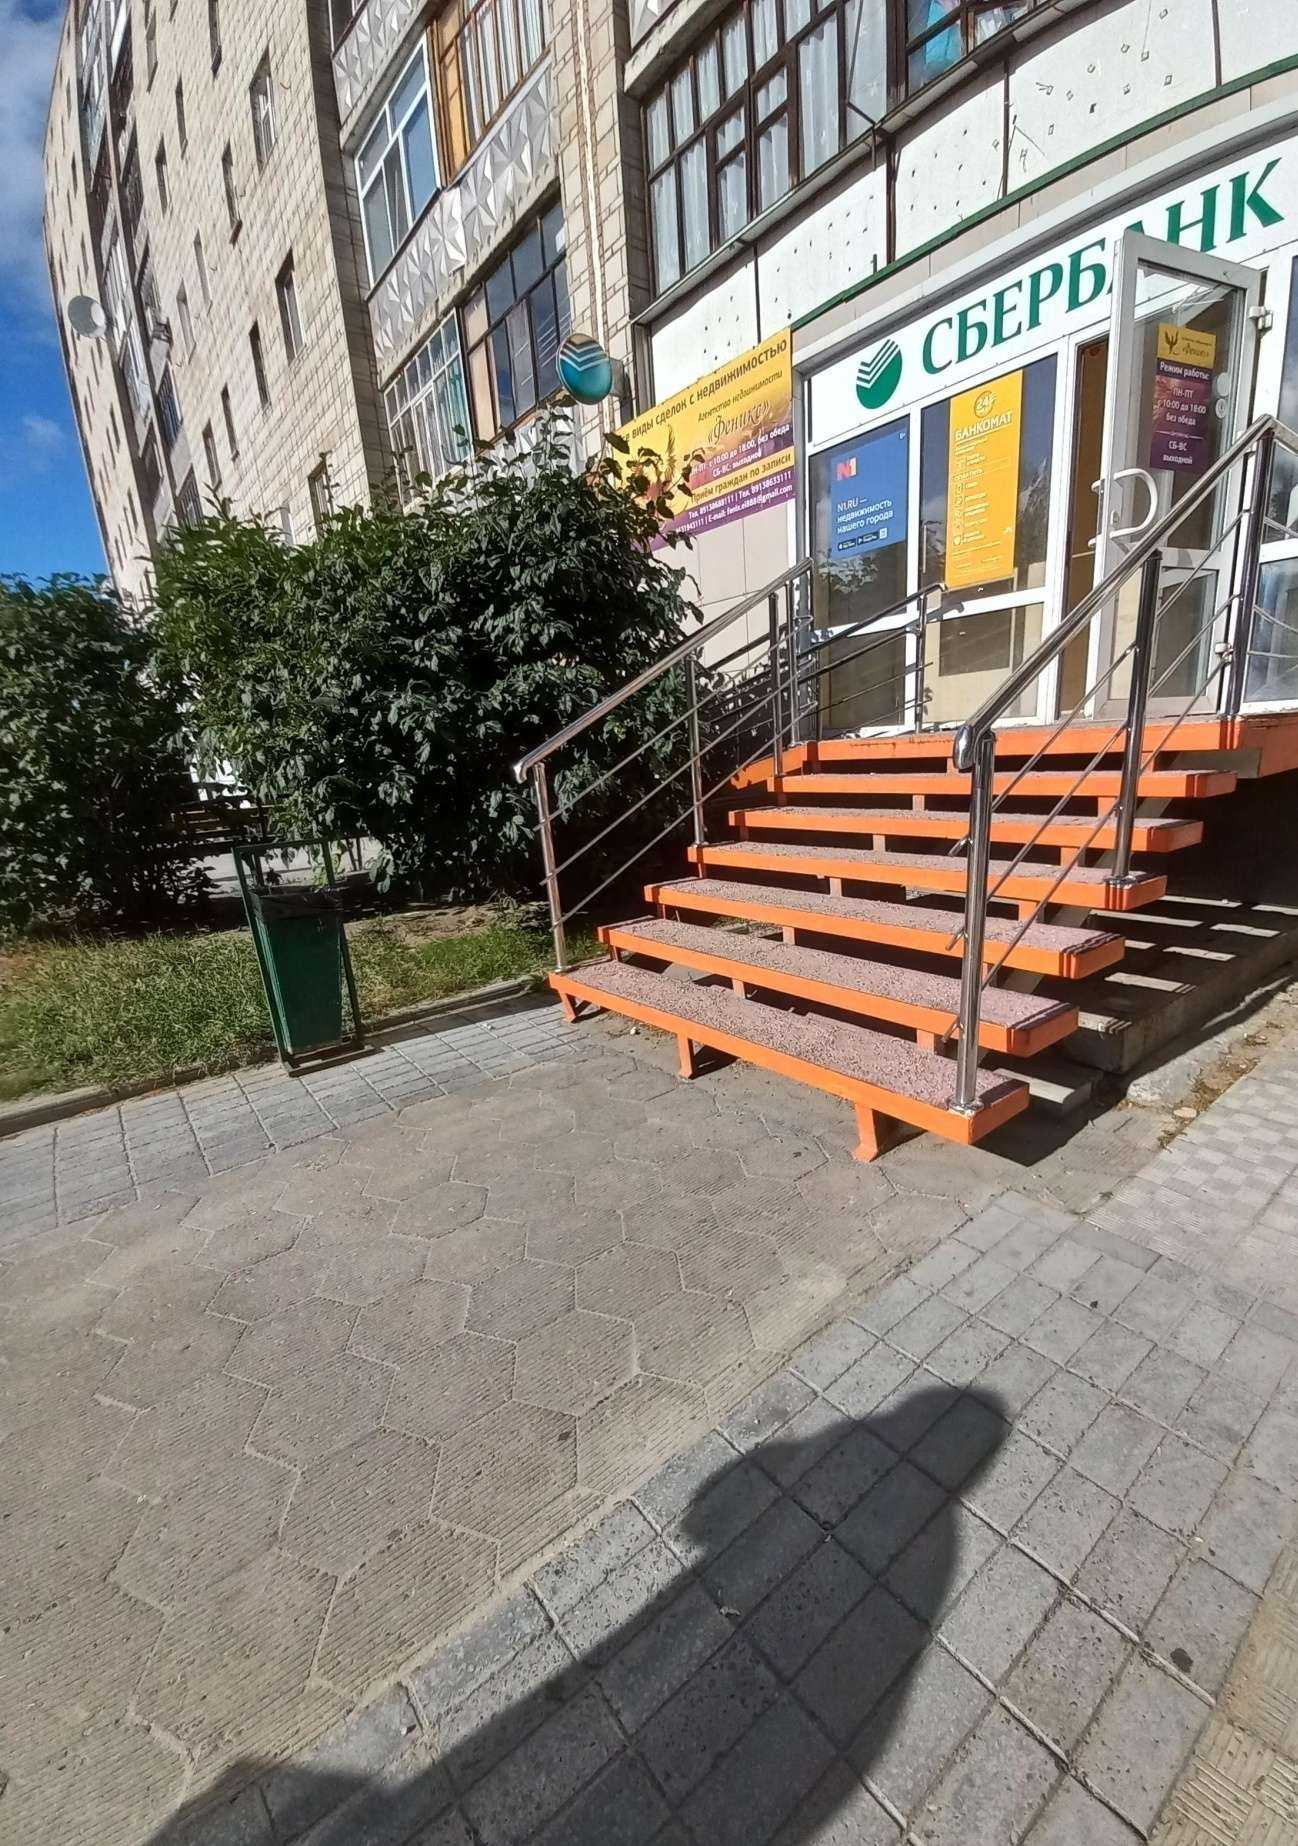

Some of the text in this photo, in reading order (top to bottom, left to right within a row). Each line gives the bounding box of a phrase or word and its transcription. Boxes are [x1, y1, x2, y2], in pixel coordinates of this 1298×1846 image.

[921, 157, 1285, 376] СБЕРБНК
[1159, 361, 1183, 375] Режим
[632, 339, 787, 439] виды сделок с недвижимостью
[955, 411, 1013, 440] БАНКОМАТ
[715, 473, 748, 495] граждан
[749, 467, 760, 478] по
[762, 454, 791, 471] записи
[837, 500, 892, 523] недвижимость
[837, 510, 894, 534] нашего города
